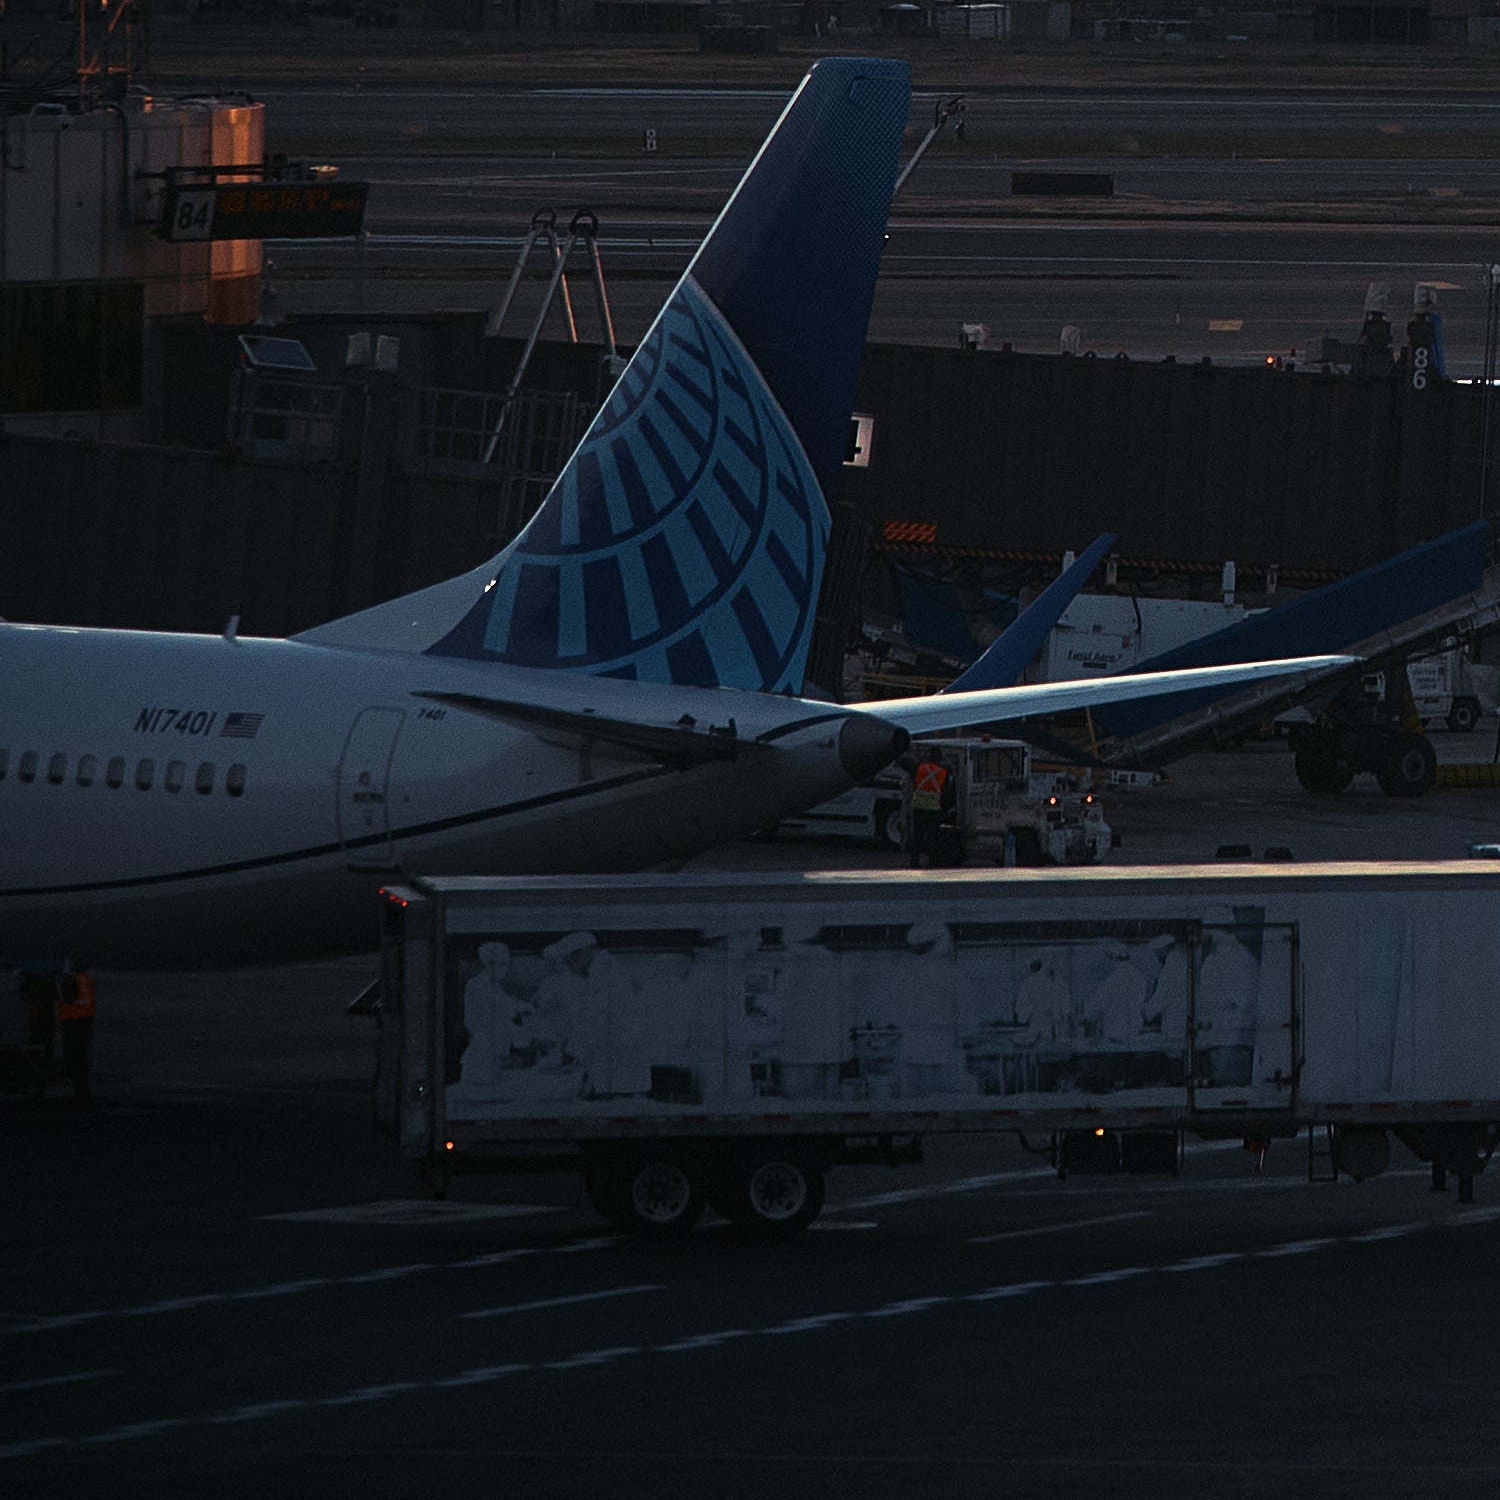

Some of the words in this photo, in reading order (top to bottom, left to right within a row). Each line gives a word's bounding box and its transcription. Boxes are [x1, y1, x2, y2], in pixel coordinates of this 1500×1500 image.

[177, 201, 209, 230] 84
[134, 708, 218, 736] N17401
[417, 708, 447, 721] 7401
